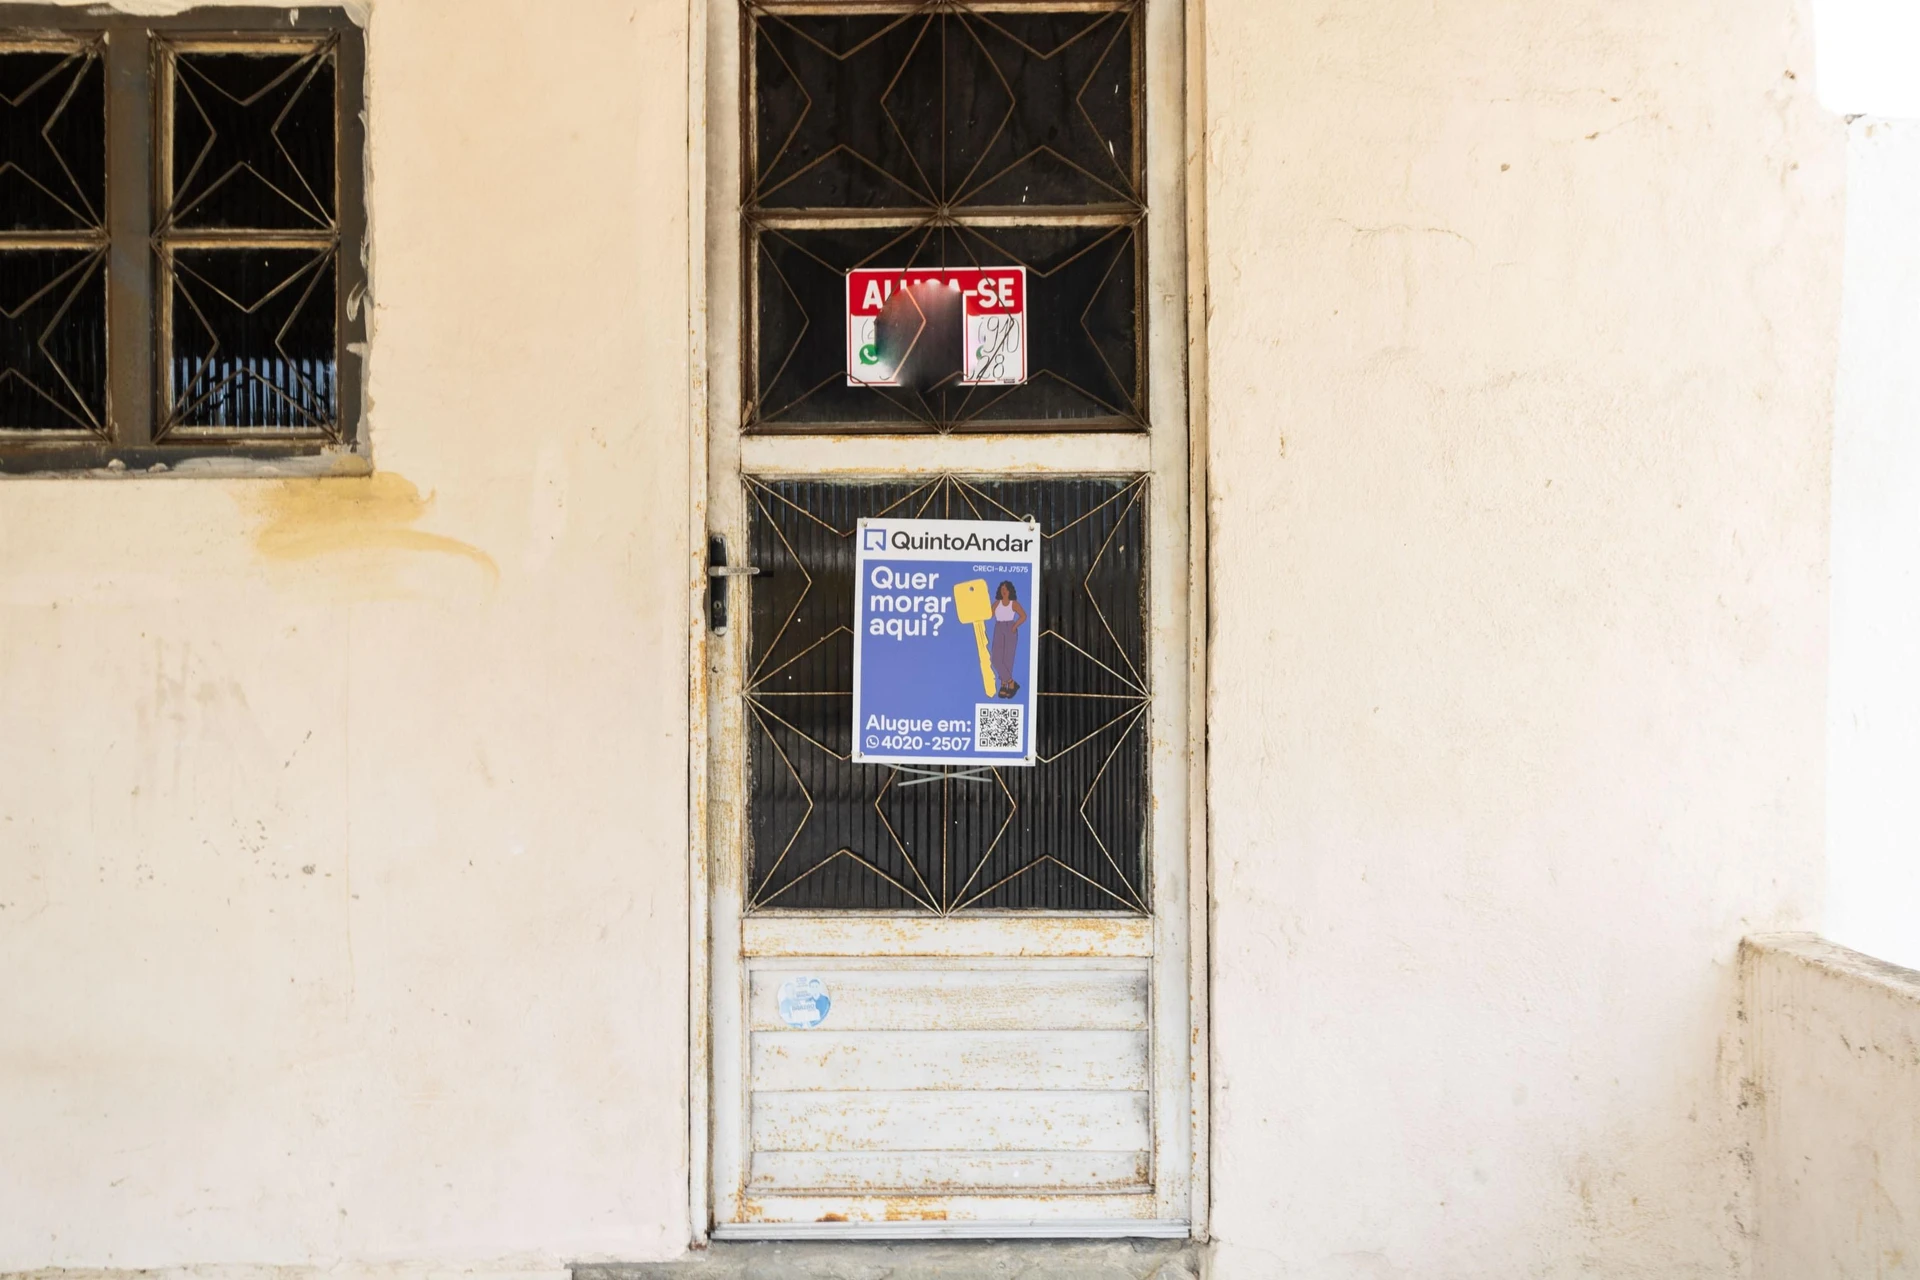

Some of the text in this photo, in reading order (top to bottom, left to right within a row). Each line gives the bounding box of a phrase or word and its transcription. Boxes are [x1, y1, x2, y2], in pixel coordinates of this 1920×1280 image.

[891, 531, 1033, 552] QuintoAndar
[871, 566, 939, 590] Quer
[871, 594, 951, 613] morar
[869, 614, 944, 641] aqui?
[866, 714, 972, 735] Alugue em:
